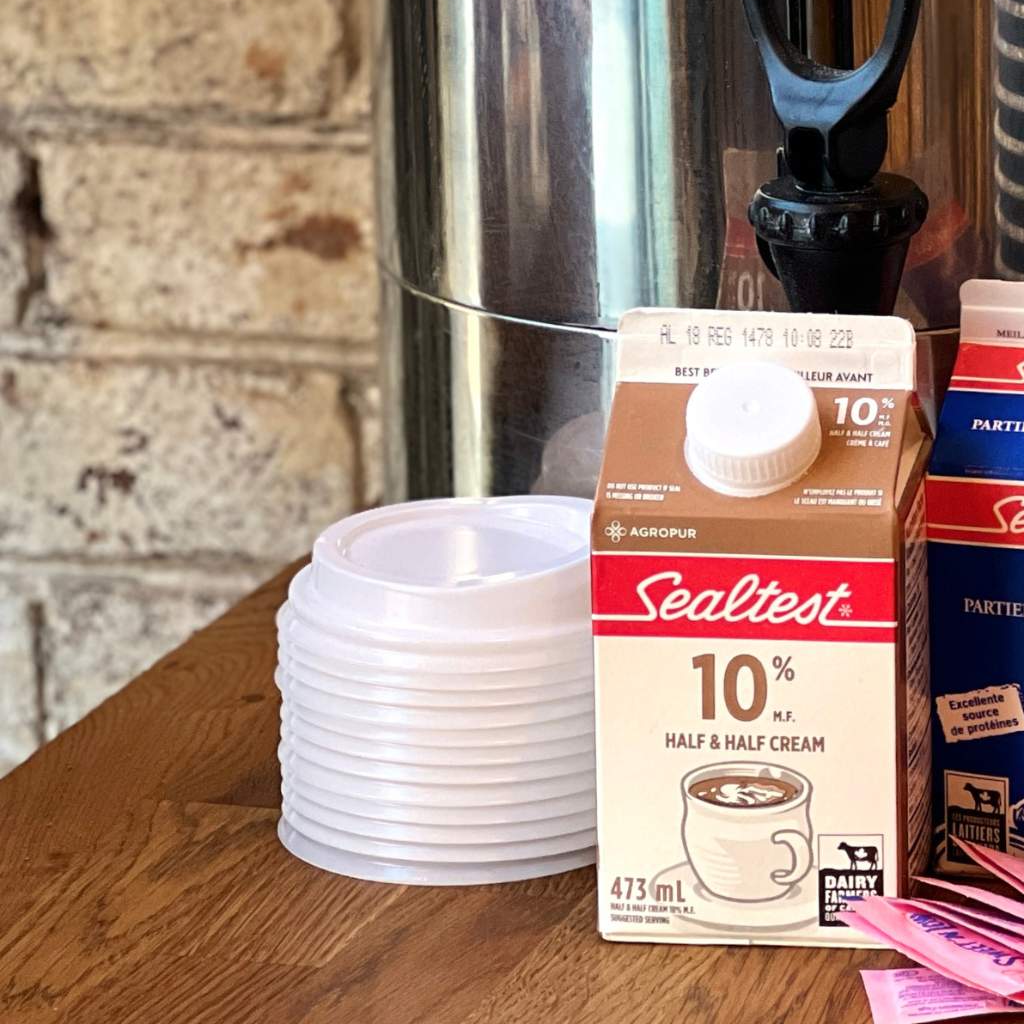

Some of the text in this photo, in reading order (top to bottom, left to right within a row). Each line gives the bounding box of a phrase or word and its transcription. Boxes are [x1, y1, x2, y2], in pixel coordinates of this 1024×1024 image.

[708, 325, 732, 346] REG
[742, 327, 774, 347] 1478
[675, 367, 700, 377] BEST
[836, 372, 873, 383] AVANT
[834, 397, 895, 426] 10%
[630, 526, 697, 540] AGROPUR
[636, 570, 853, 624] Sealtest
[692, 653, 795, 723] 10%
[949, 693, 1005, 711] Excellente
[773, 710, 797, 724] M.F.
[962, 707, 1000, 721] source
[950, 717, 1020, 737] de protéines
[665, 732, 826, 754] HALF & HALF CREAM
[610, 876, 686, 902] 473 mL
[825, 875, 878, 889] DAIRY
